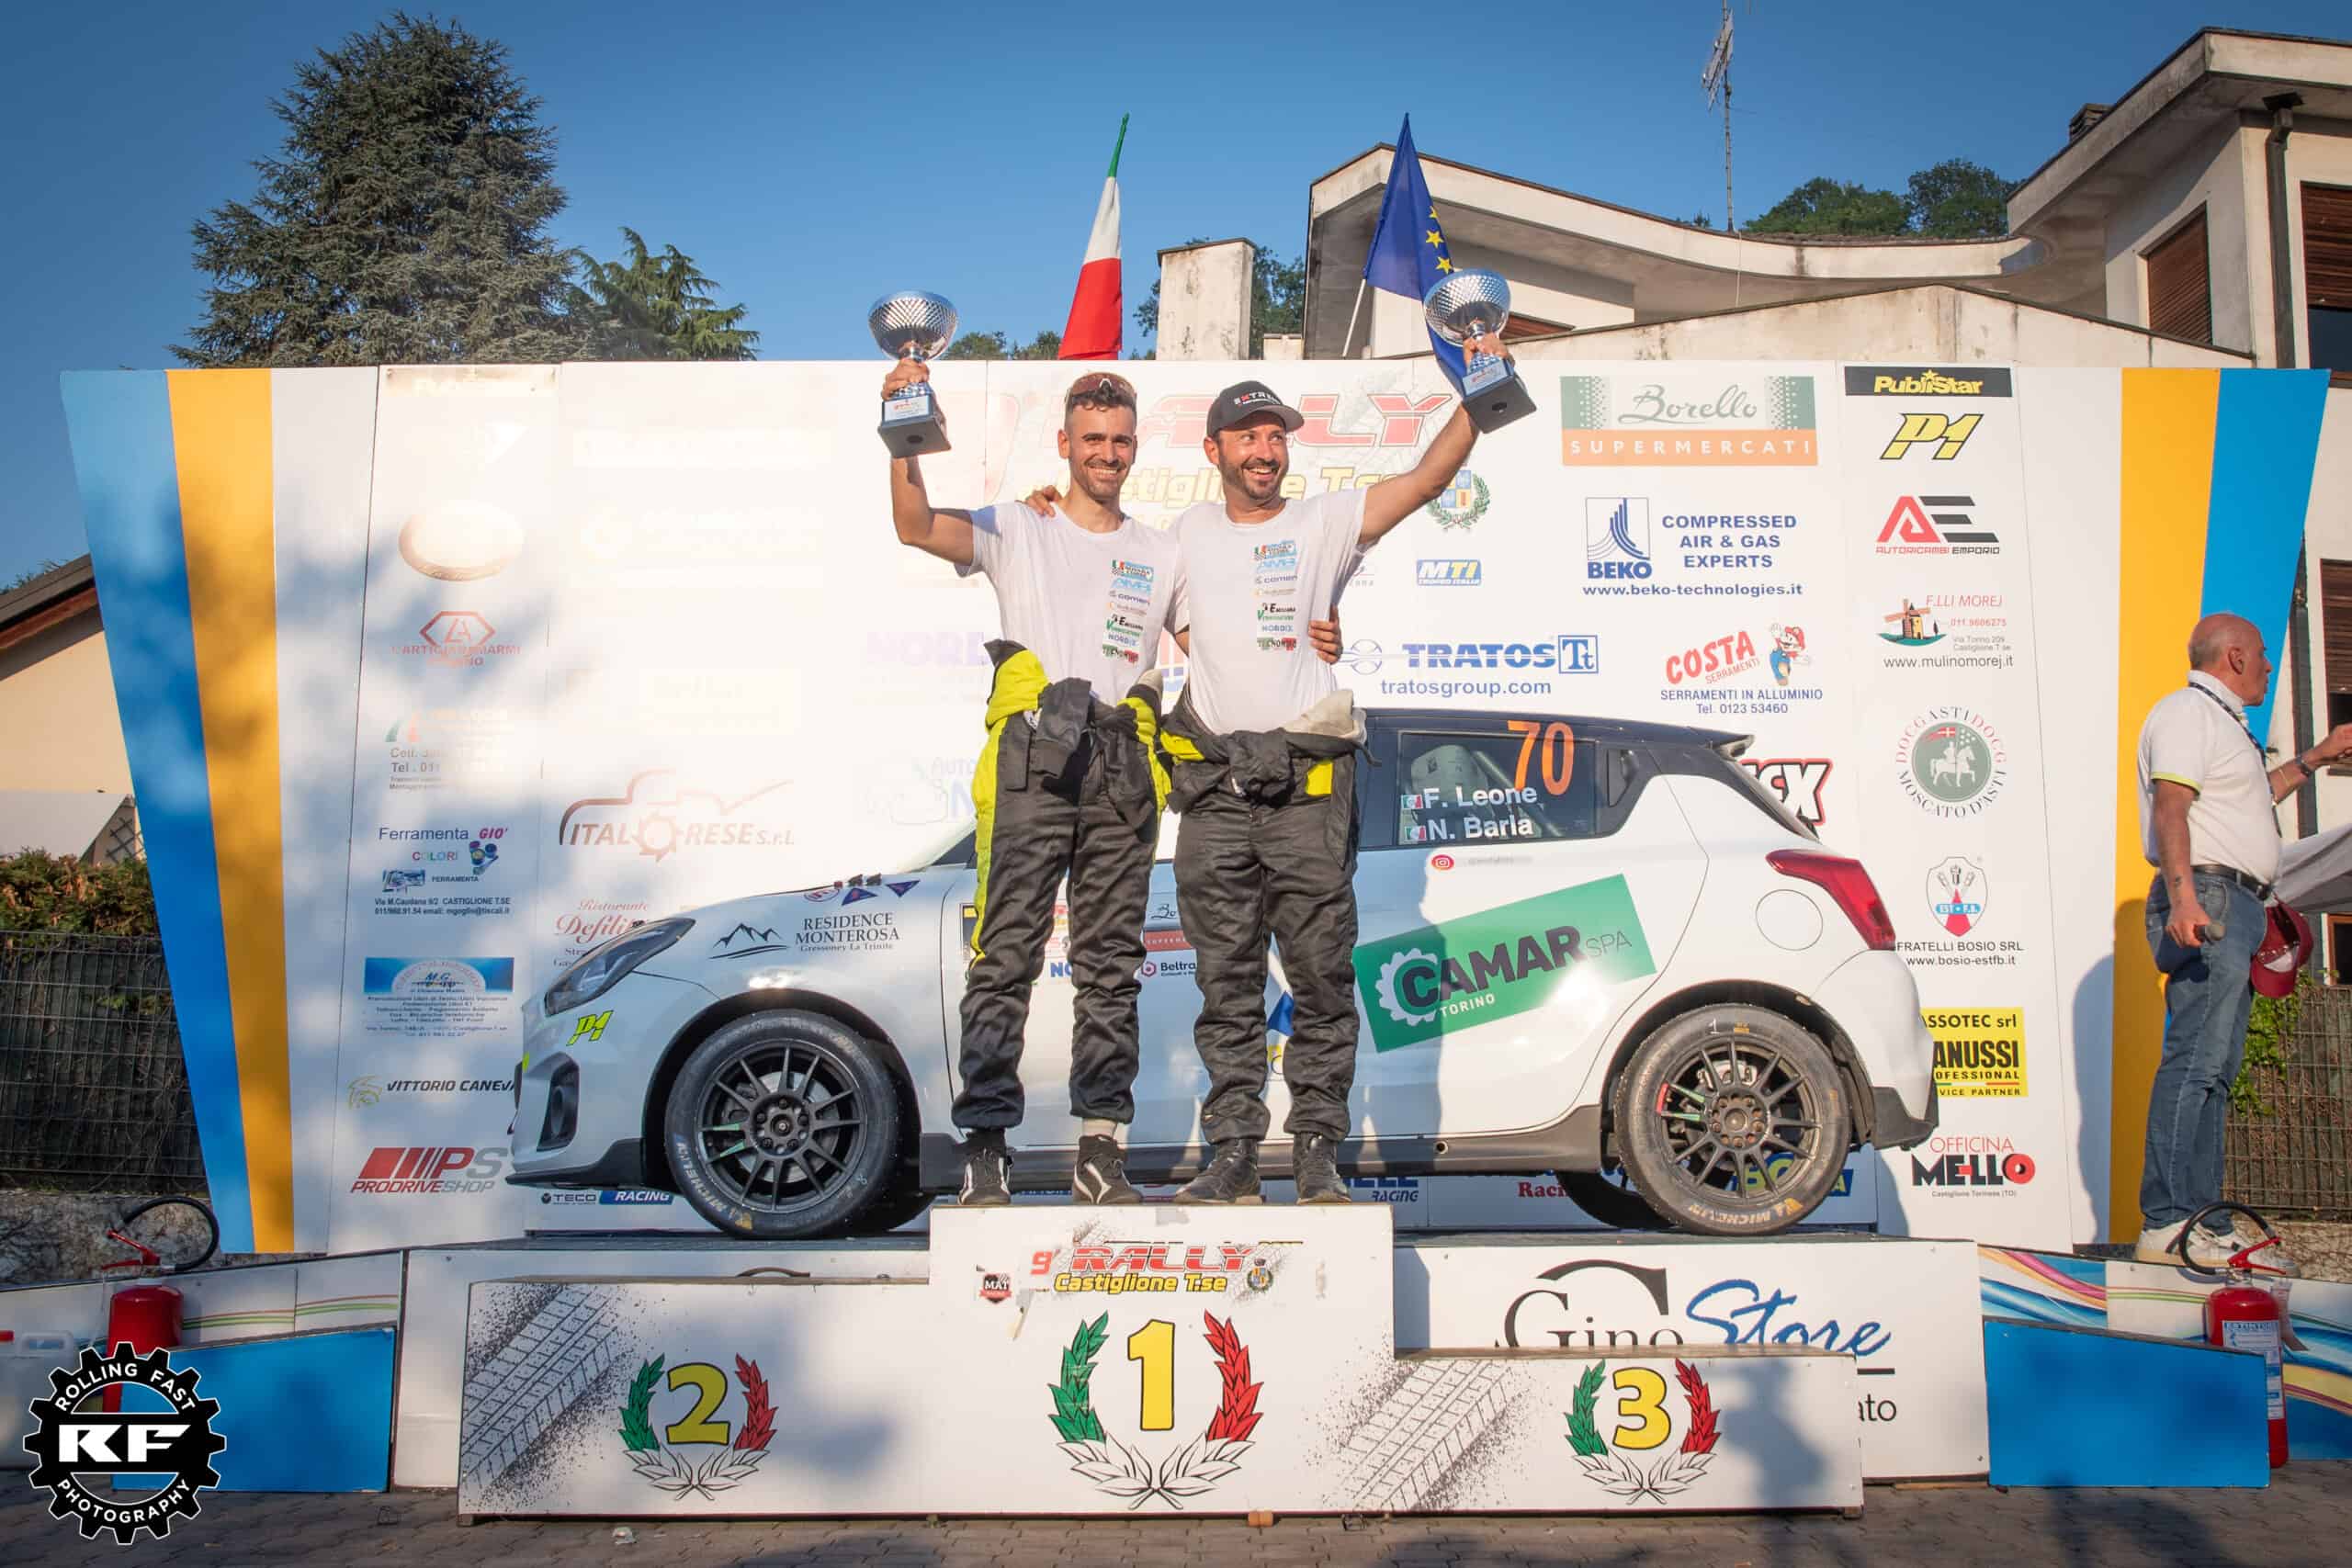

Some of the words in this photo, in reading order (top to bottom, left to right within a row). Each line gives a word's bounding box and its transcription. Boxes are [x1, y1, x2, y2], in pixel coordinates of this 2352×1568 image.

[1874, 369, 1983, 394] PubliStar
[1618, 383, 1758, 424] Borello
[1879, 412, 1984, 460] P1
[1569, 440, 1811, 455] SUPERMERCATI
[1661, 515, 1798, 529] COMPRESSED
[1679, 535, 1713, 548] AIR
[1720, 535, 1734, 548] &
[1741, 535, 1781, 549] GAS
[1951, 547, 2000, 555] EMPORIO
[1419, 561, 1478, 579] MTI
[1588, 561, 1652, 579] BEKO
[1683, 555, 1773, 569] EXPERTS
[1583, 583, 1803, 598] www.beko-technologies.it
[1402, 643, 1556, 668] TRATOS
[1666, 631, 1756, 684] COSTA
[1883, 654, 2014, 669] www.mulinomorej.it
[1705, 658, 1760, 684] SERRAMENTI
[1381, 680, 1552, 697] tratosgroup.com
[1660, 689, 1738, 700] SERRAMENTI
[1741, 689, 1754, 700] IN
[1757, 689, 1824, 700] ALLUMINIO
[1719, 704, 1747, 714] 0123
[1750, 704, 1789, 714] 53460
[1928, 705, 1970, 721] ASTI
[1971, 714, 2007, 764] DOCG
[1507, 719, 1575, 796] 70
[1424, 787, 1449, 809] F.
[1454, 785, 1538, 807] Leone
[1898, 770, 1967, 818] MOSCATO
[1969, 770, 2007, 815] D'ASTI
[379, 828, 469, 840] Ferramenta
[1428, 818, 1456, 840] N.
[1464, 815, 1534, 839] Barla
[412, 852, 458, 862] COLORI
[442, 897, 494, 906] CASTIGLIONE
[580, 898, 648, 911] Ristorante
[802, 912, 893, 931] RESIDENCE
[796, 927, 900, 945] MONTEROSA
[1896, 942, 1954, 952] FRATELLI
[1957, 942, 1996, 952] BOSIO
[1999, 942, 2024, 952] SRL
[1401, 925, 1588, 1009] CAMAR
[1585, 930, 1633, 959] SPA
[1905, 955, 2017, 965] www.bosio-estfb.it
[1438, 992, 1497, 1019] TORINO
[1996, 1013, 2018, 1028] srl
[386, 1080, 454, 1092] VITTORIO
[1929, 1135, 2015, 1153] OFFICINA
[1911, 1153, 2036, 1186] MELLO
[553, 1193, 597, 1202] TECO
[615, 1190, 670, 1201] RACING
[1371, 1190, 1419, 1202] RACING
[1069, 1245, 1261, 1272] RALLY
[1054, 1272, 1177, 1295] Castiglione
[1183, 1272, 1227, 1293] T.se
[1684, 1278, 1893, 1357] Store
[1126, 1318, 1177, 1432] 1
[665, 1361, 731, 1446] 2
[1611, 1365, 1672, 1451] 3
